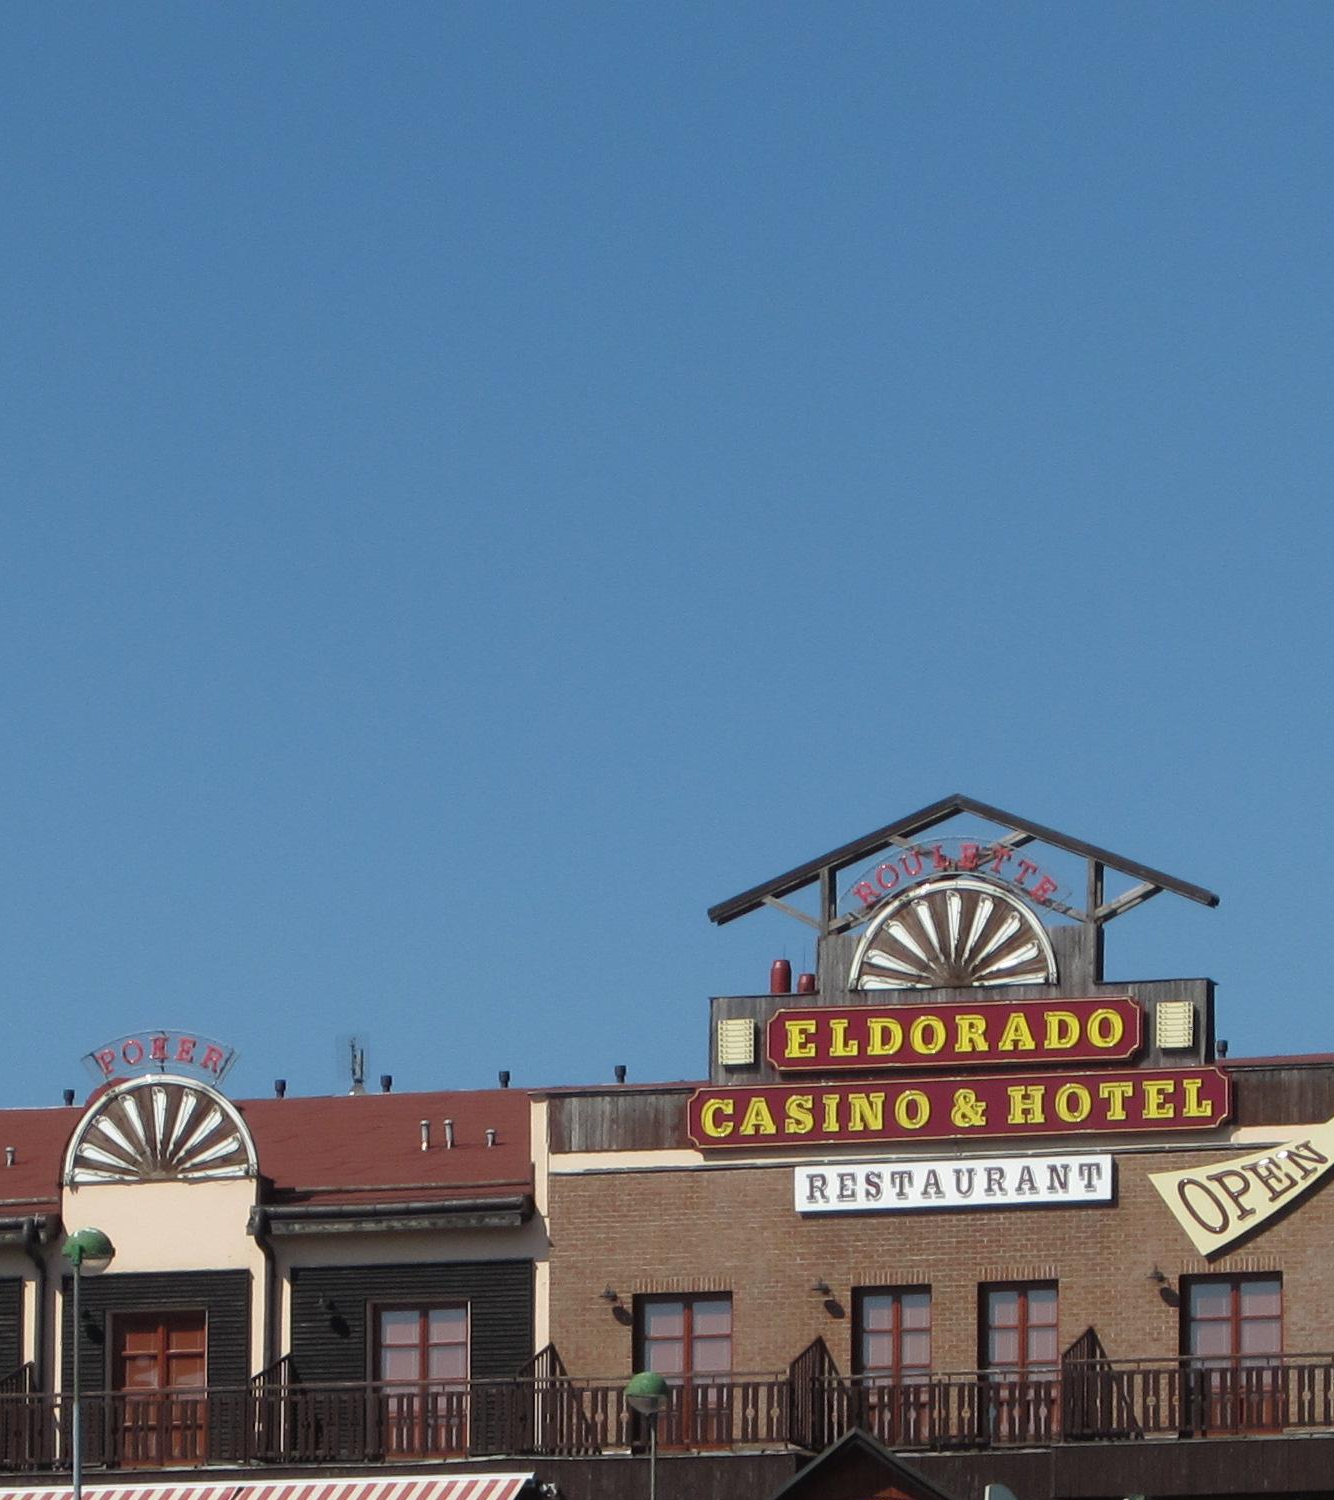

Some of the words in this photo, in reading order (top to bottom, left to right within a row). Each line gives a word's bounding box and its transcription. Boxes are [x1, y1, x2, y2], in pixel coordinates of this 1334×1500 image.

[853, 843, 1058, 906] ROULETTE
[96, 1035, 224, 1075] POKER
[784, 1008, 1124, 1058] ELDORADO
[700, 1088, 931, 1137] CASINO
[951, 1088, 987, 1128] &
[1007, 1078, 1212, 1125] HOTEL
[805, 1161, 1103, 1202] RESTAURANT
[1177, 1140, 1329, 1235] OPEN
